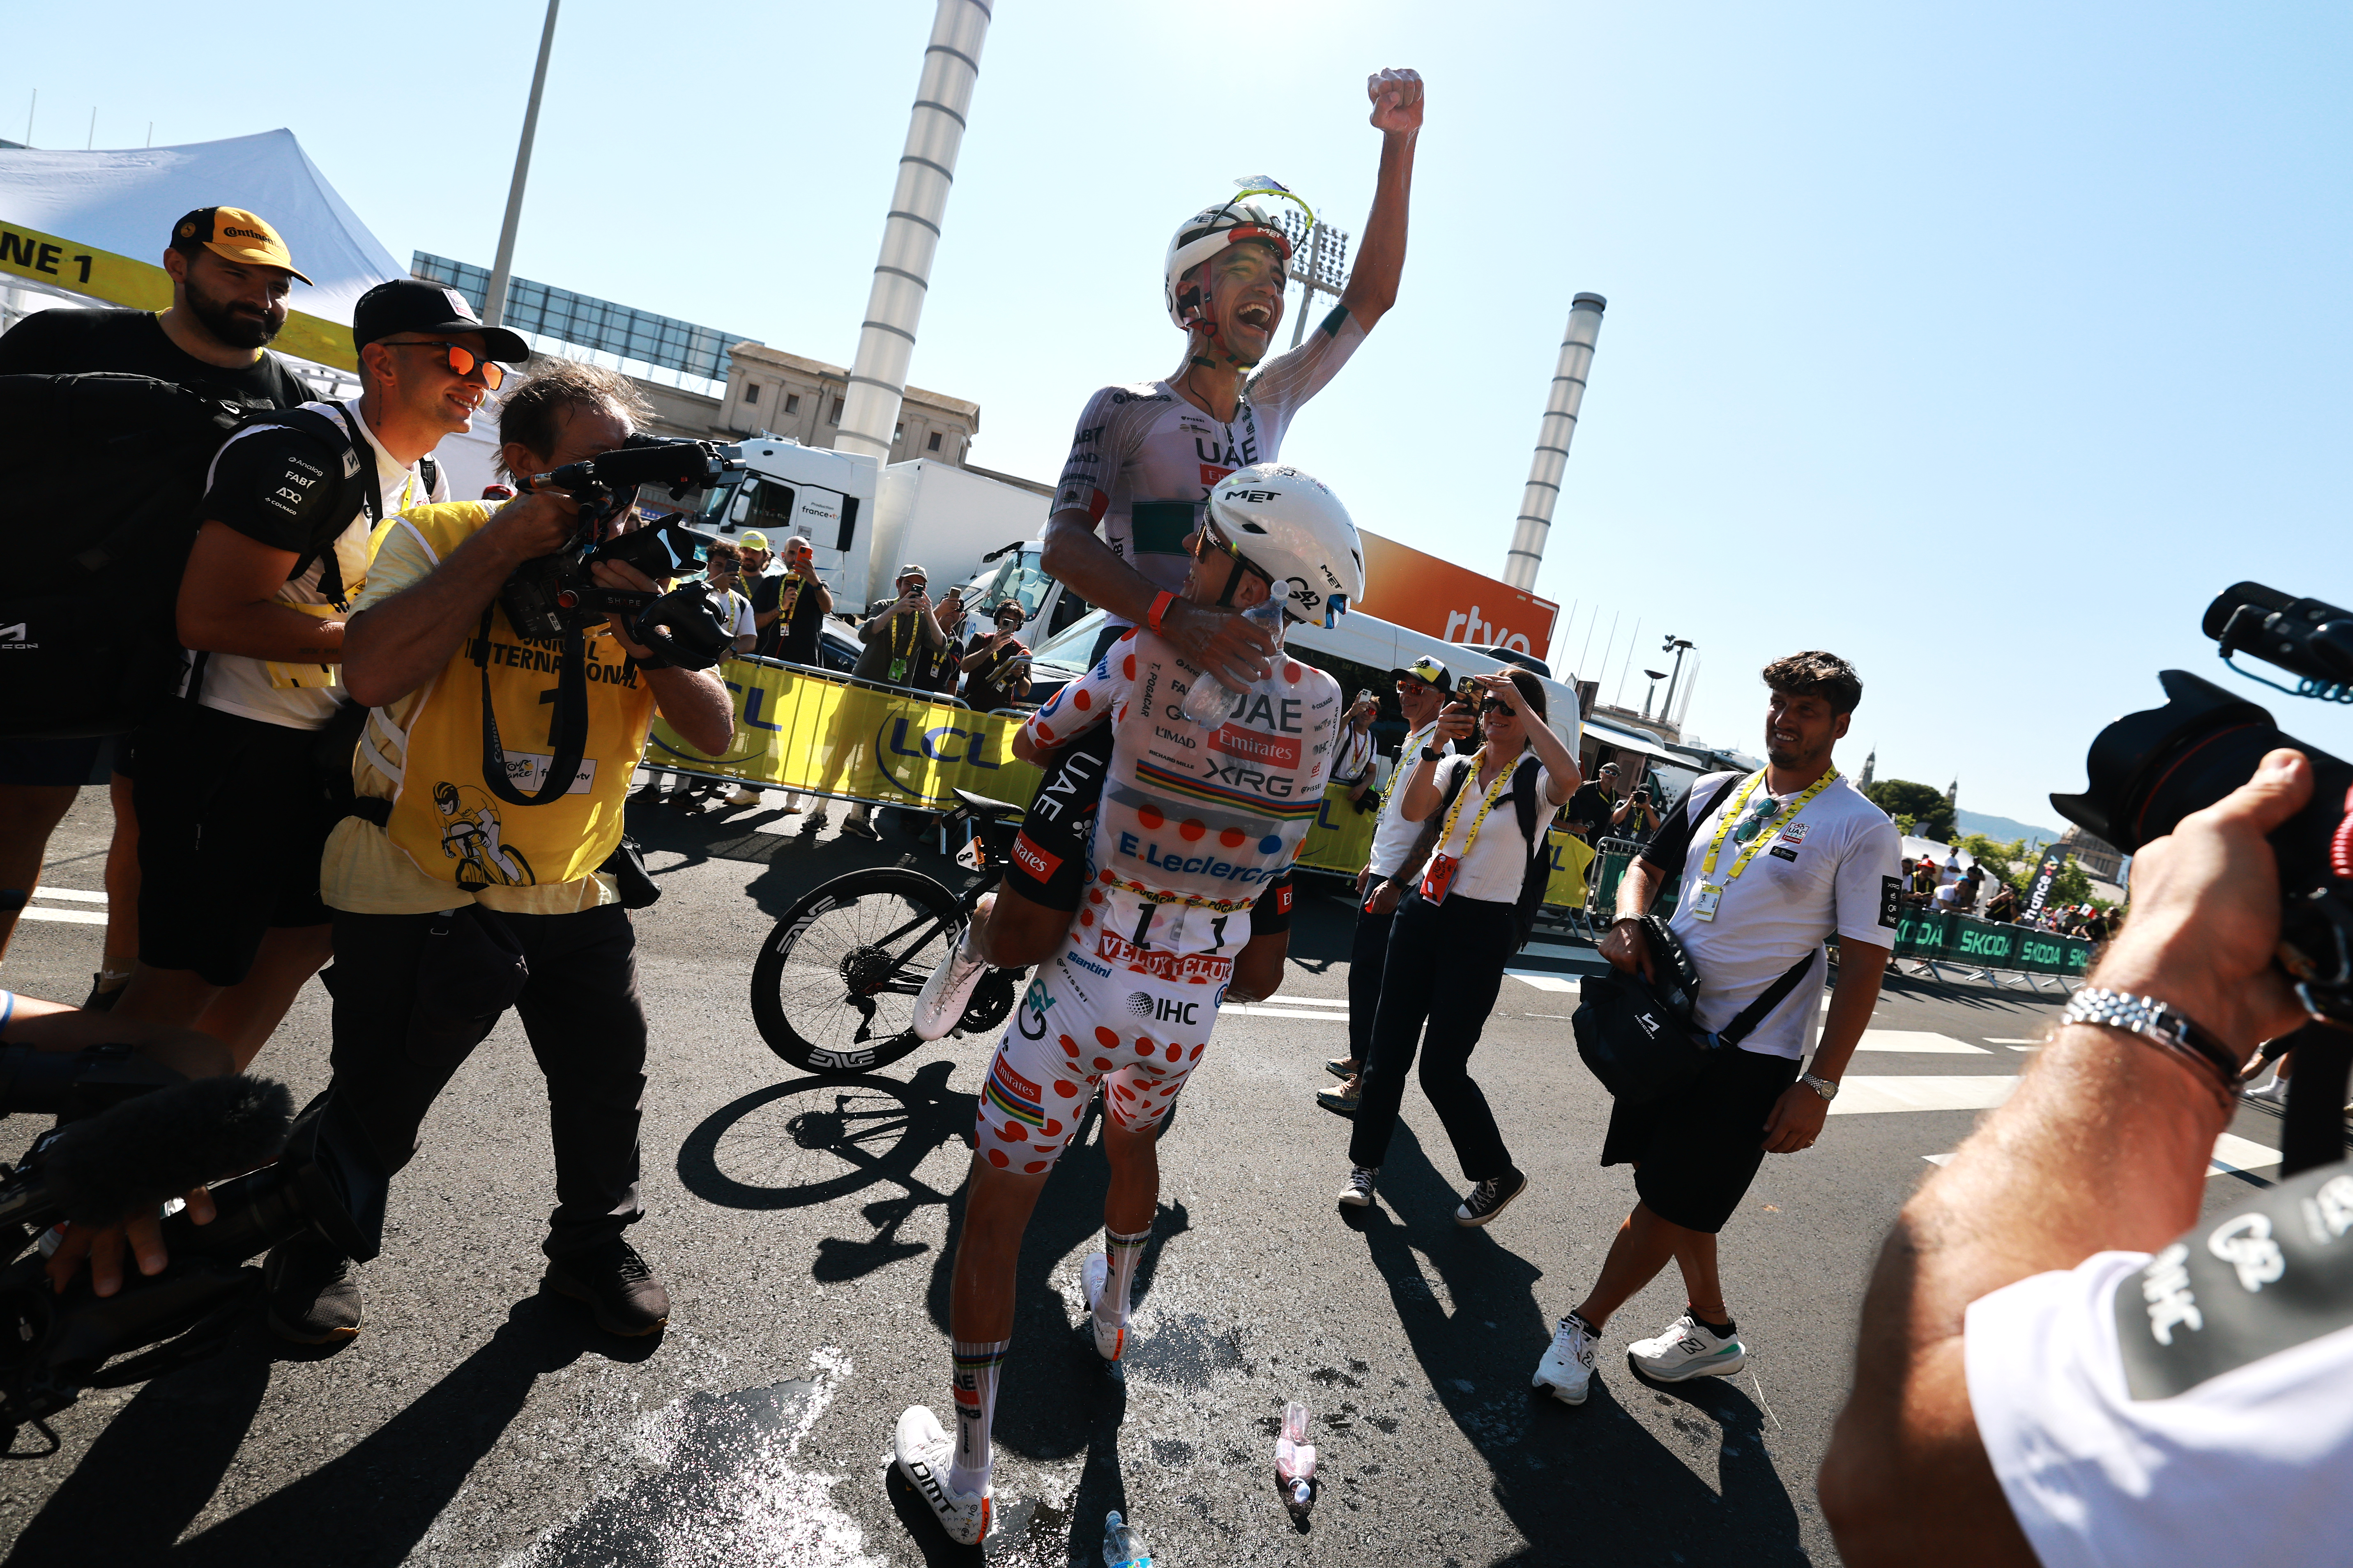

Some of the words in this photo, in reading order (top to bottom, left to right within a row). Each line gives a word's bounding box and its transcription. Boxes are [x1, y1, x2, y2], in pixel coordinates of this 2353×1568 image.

[1257, 227, 1282, 238] MET
[73, 255, 92, 283] 1
[1196, 437, 1258, 467] UAE
[296, 460, 323, 476] Analog
[1059, 474, 1097, 484] mirates
[271, 500, 297, 515] COLNAGO
[276, 487, 302, 504] ADQ
[811, 502, 834, 510] Production
[1225, 490, 1281, 503] MET
[1320, 564, 1342, 589] MET
[608, 597, 641, 606] SHAPE
[1285, 577, 1320, 611] G42
[465, 638, 638, 690] ITERNAONAL
[1141, 672, 1158, 717] POGACAR
[1316, 697, 1333, 709] COLNAGO
[890, 717, 1002, 771] LCL
[1156, 726, 1196, 749] L'IMAD
[1219, 728, 1292, 760] Emirates
[1318, 740, 1329, 754] IHC
[1149, 750, 1175, 764] RICHARD
[1176, 760, 1195, 769] MILLE
[507, 770, 533, 779] ance
[1033, 752, 1103, 821] UAE
[1202, 758, 1294, 798] XRG
[1307, 783, 1321, 792] PISSEI
[1788, 828, 1805, 836] UAE
[958, 852, 973, 862] 8
[1014, 836, 1048, 872] mirates
[1208, 901, 1244, 913] POGACAR
[1130, 903, 1157, 950] 1
[1200, 915, 1228, 954] 1
[1895, 920, 1942, 947] KODA
[1067, 951, 1112, 978] Santini
[1103, 936, 1171, 975] VELUX
[1063, 968, 1087, 1002] PISSEI
[1018, 978, 1056, 1040] G42
[1156, 998, 1199, 1025] IHC
[997, 1060, 1034, 1096] Emirates
